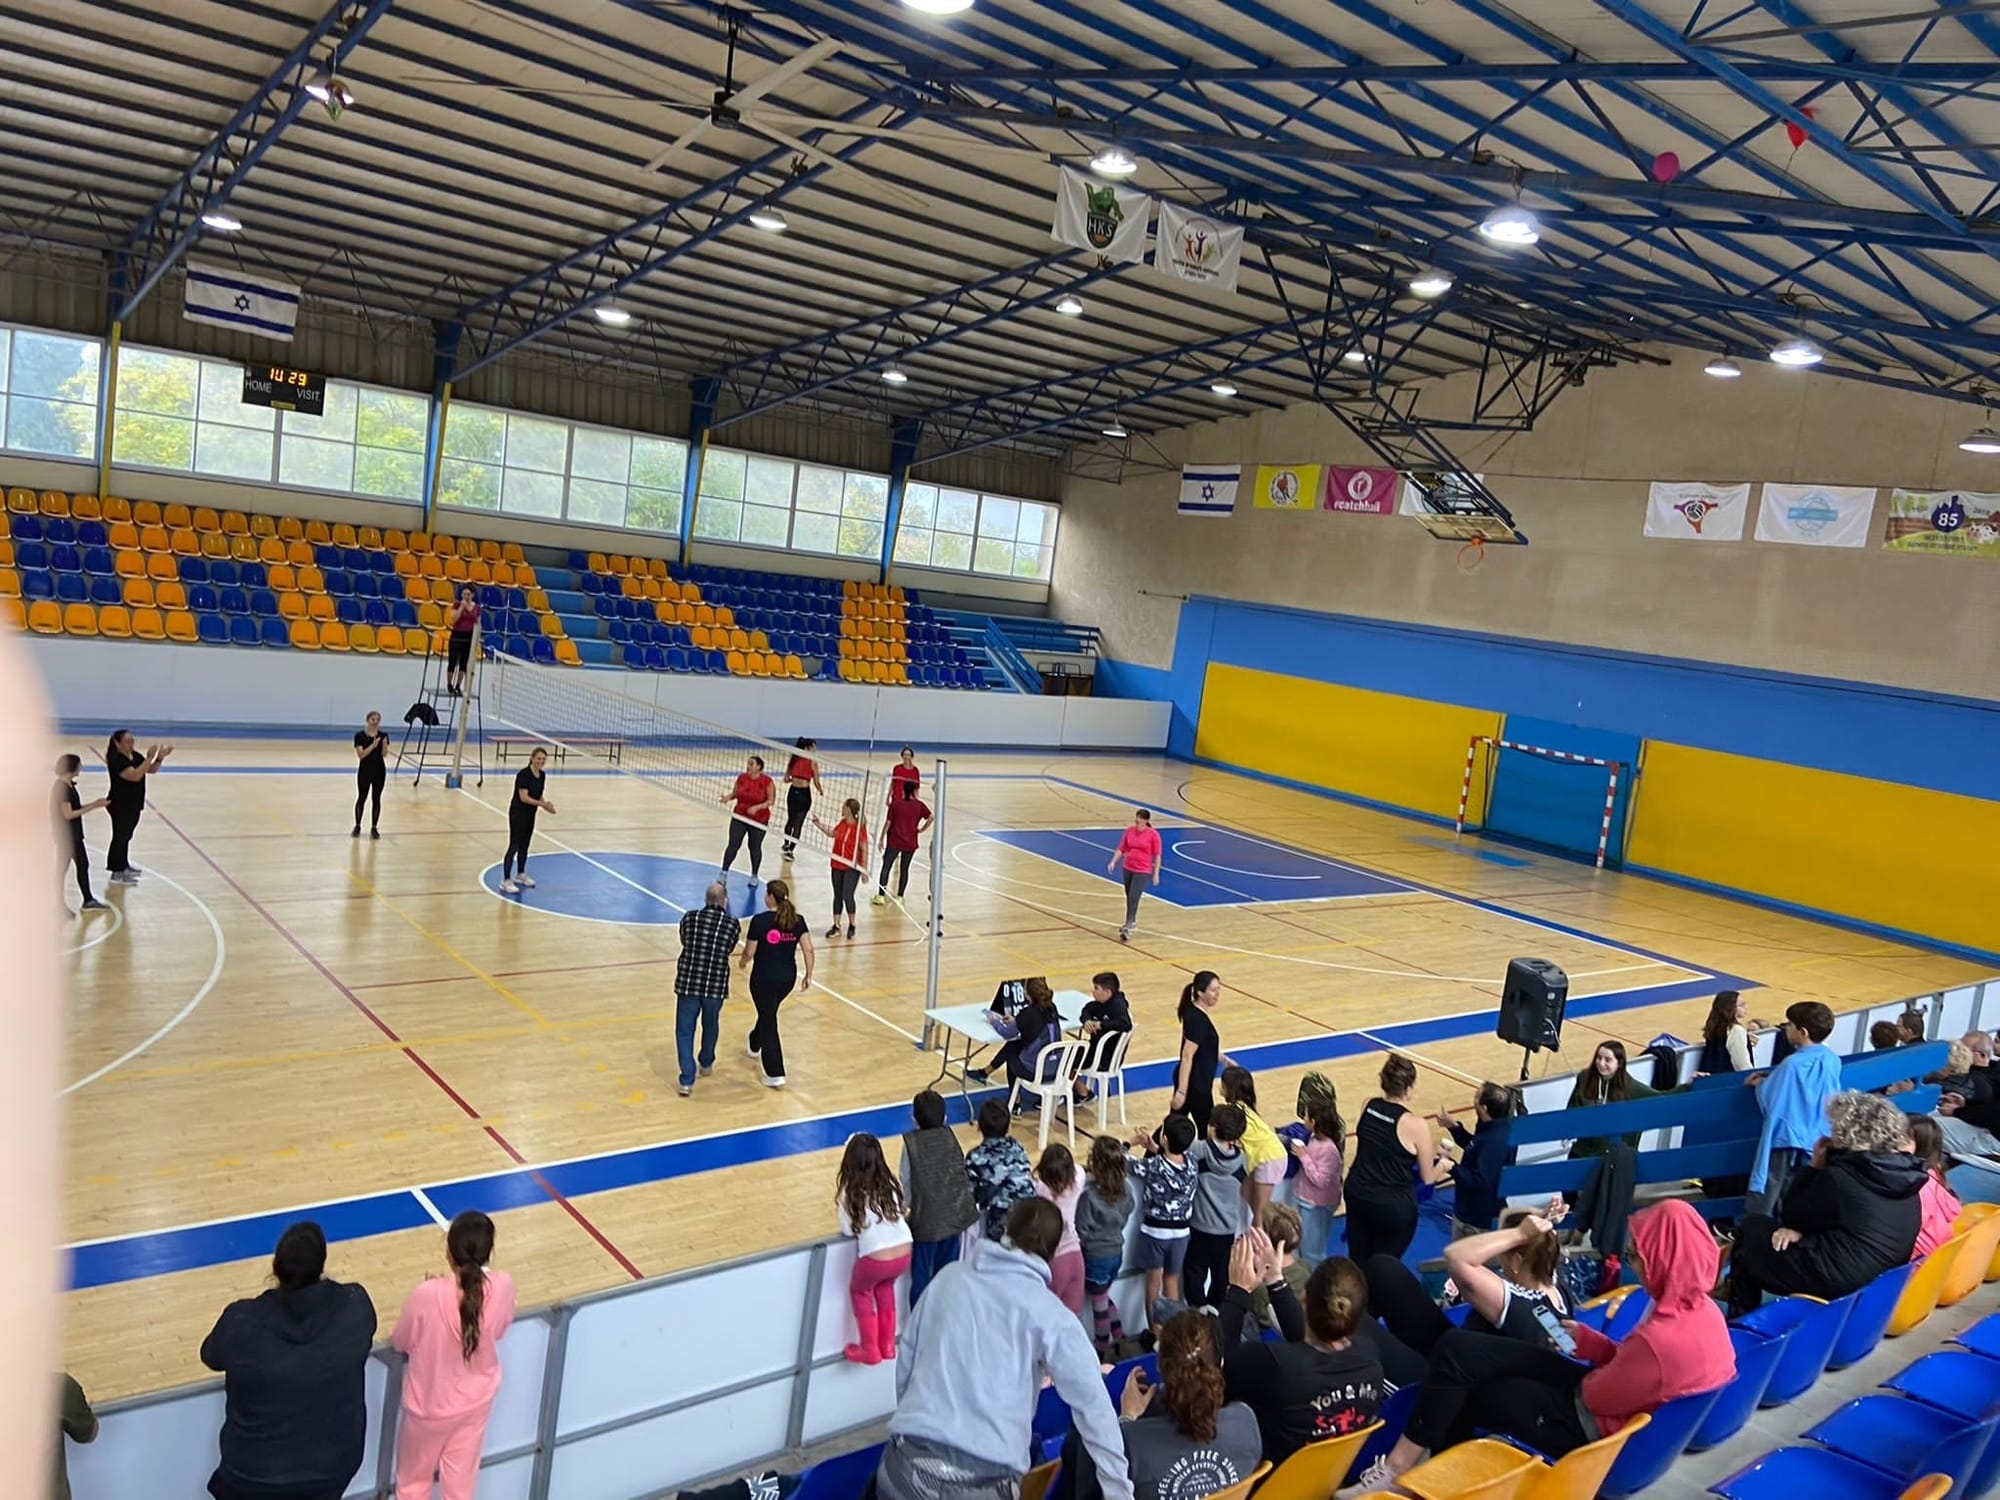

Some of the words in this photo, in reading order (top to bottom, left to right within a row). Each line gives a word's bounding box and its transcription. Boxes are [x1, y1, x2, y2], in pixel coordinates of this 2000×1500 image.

[1088, 217, 1113, 238] HKS
[245, 379, 272, 393] HOME
[287, 371, 308, 387] 29
[296, 387, 320, 401] VISIT
[1938, 513, 1959, 527] 85
[1011, 985, 1025, 1004] 18
[1310, 1389, 1342, 1412] You
[1344, 1384, 1356, 1400] &
[1192, 1450, 1220, 1462] FREE
